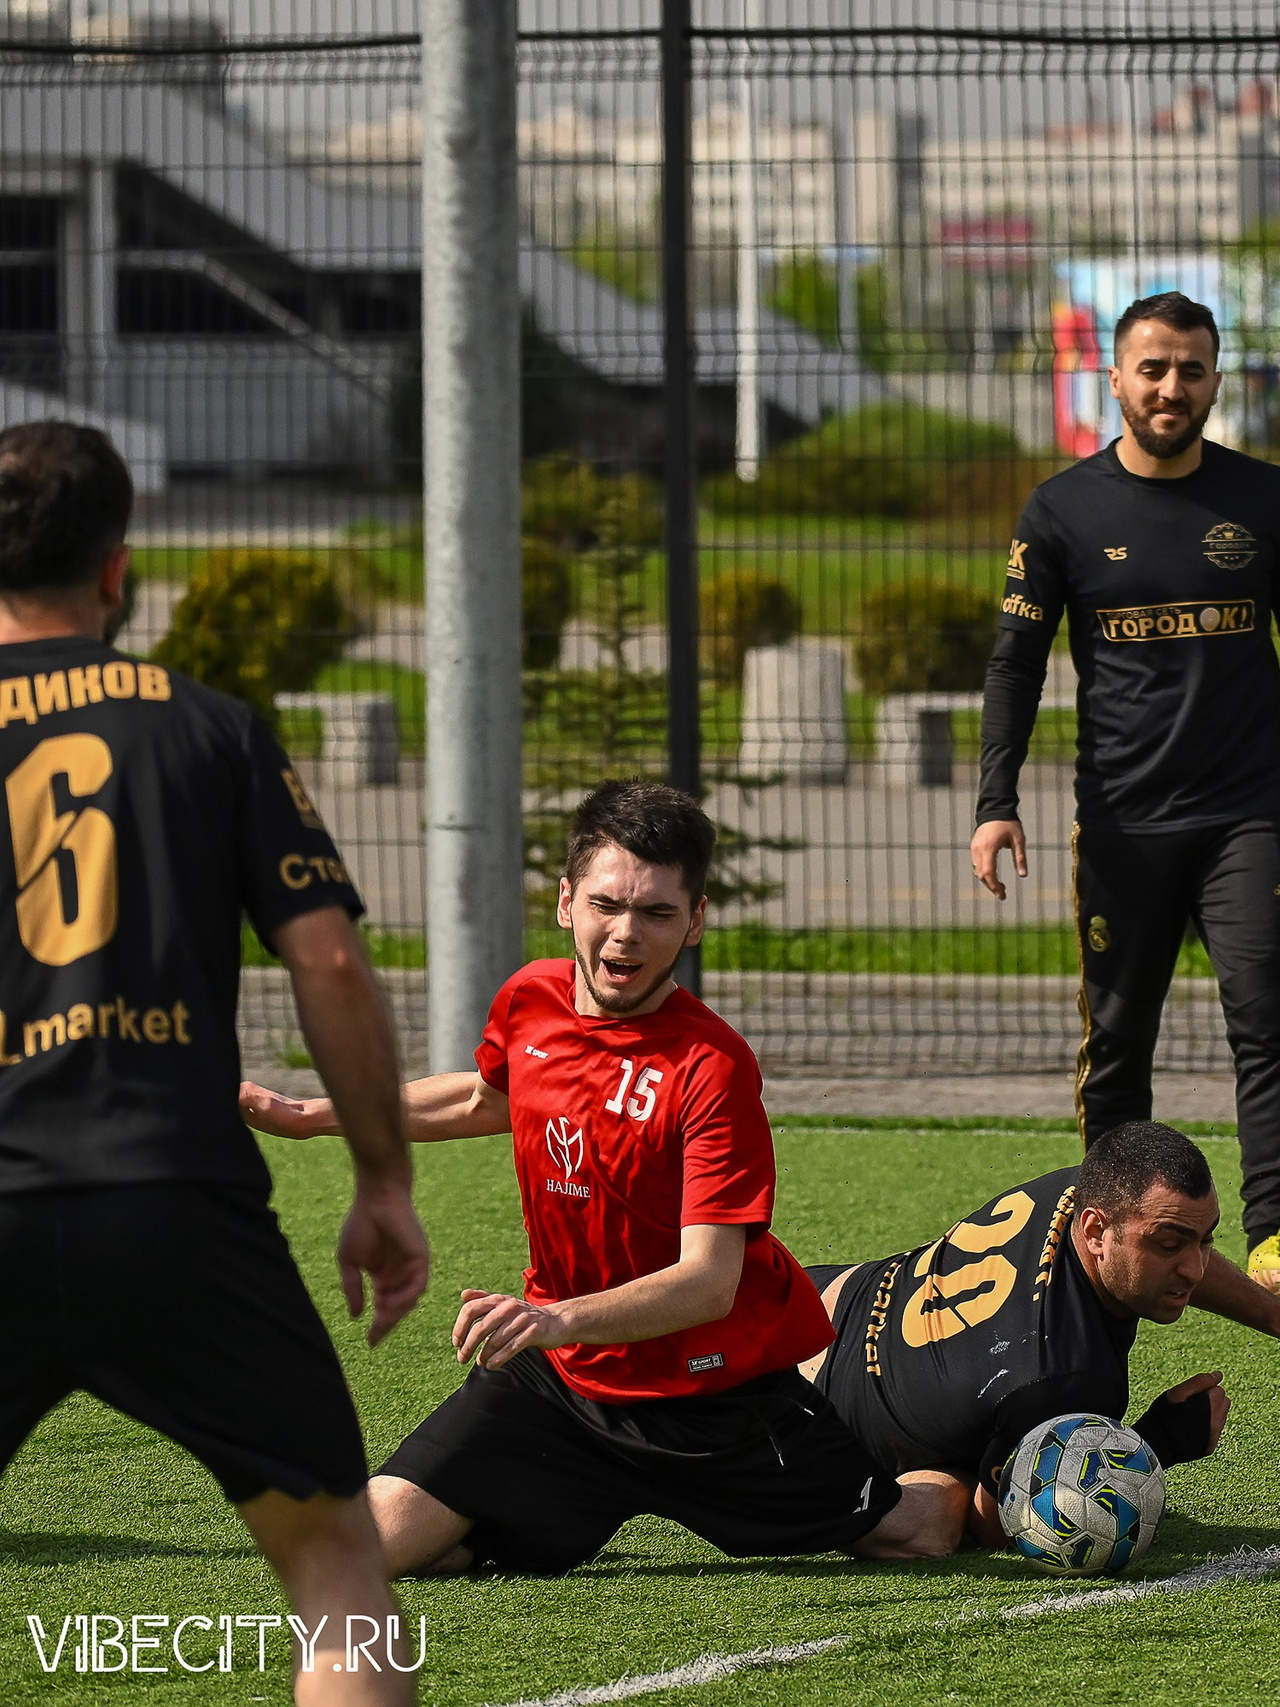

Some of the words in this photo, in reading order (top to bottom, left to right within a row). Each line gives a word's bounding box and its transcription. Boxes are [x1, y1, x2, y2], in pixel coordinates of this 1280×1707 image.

[1155, 607, 1182, 616] СЕТЬ
[5, 732, 120, 968] 6
[604, 1058, 664, 1122] 15
[546, 1178, 591, 1199] HAJIME
[902, 1189, 1036, 1348] 20
